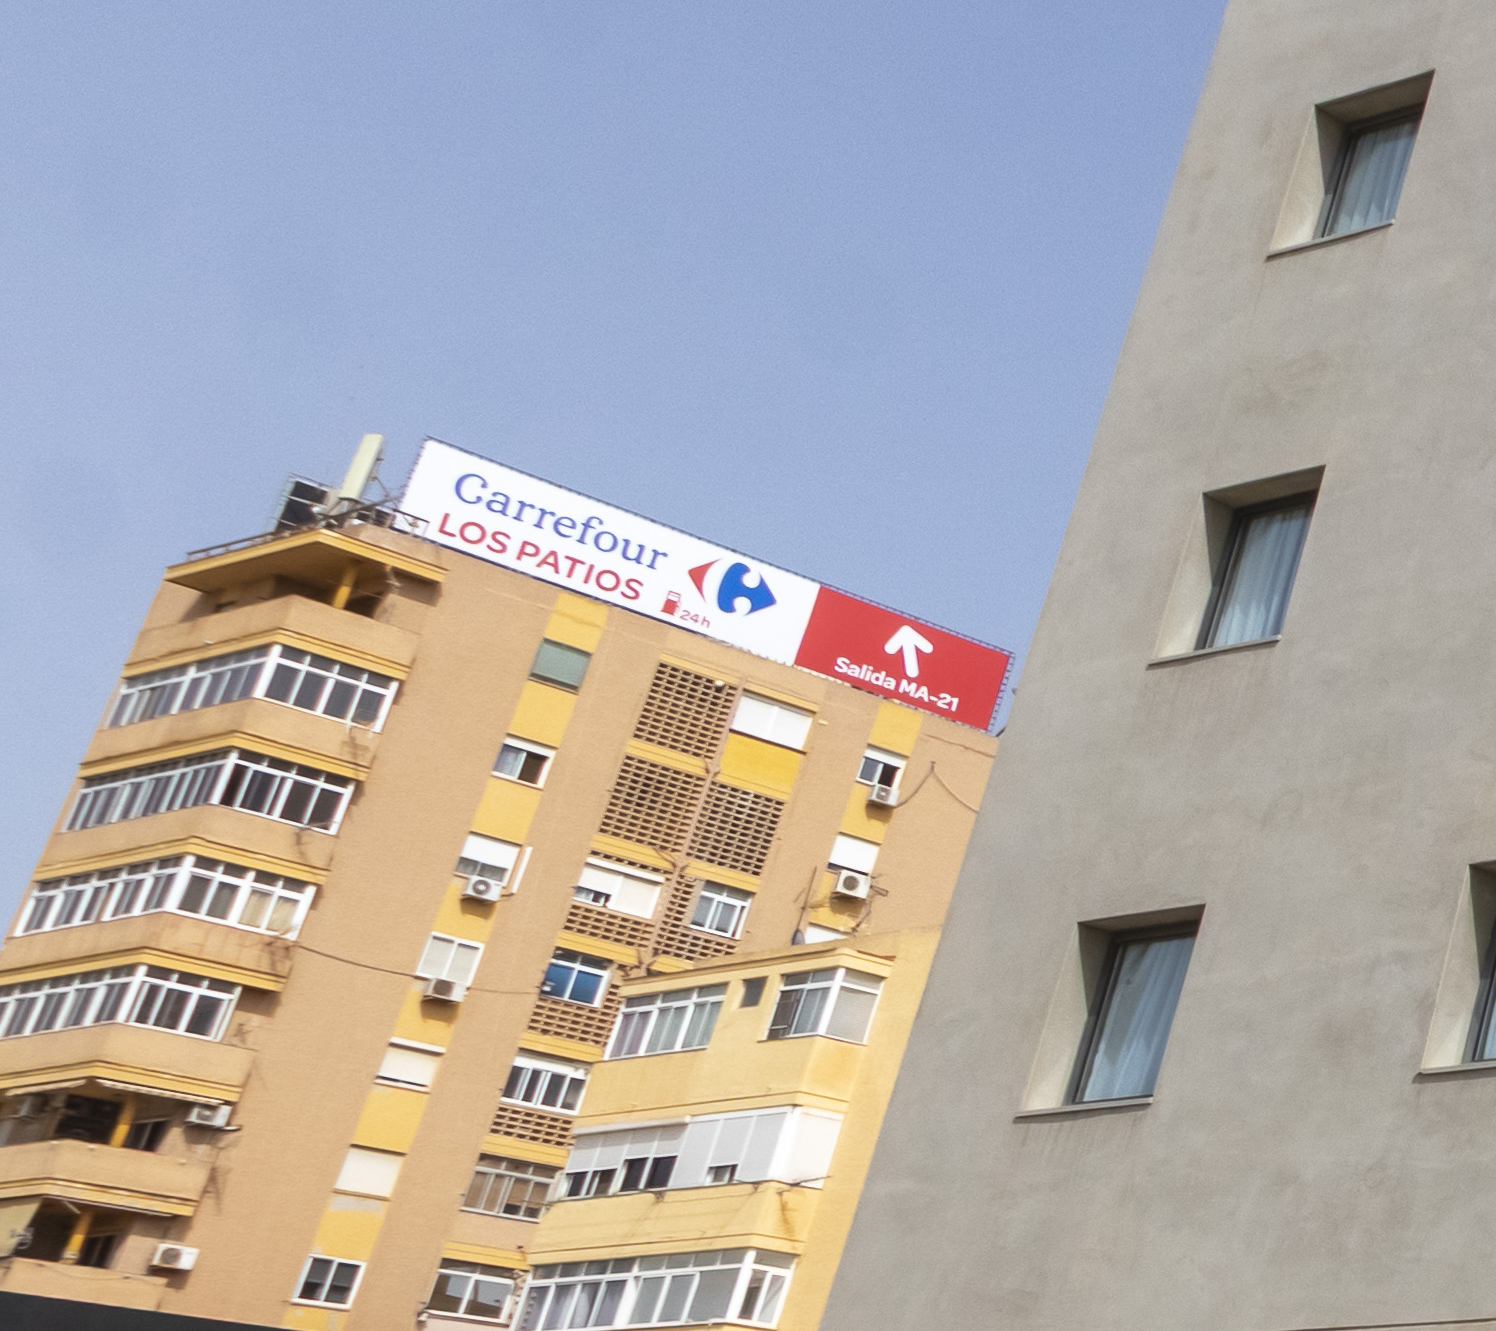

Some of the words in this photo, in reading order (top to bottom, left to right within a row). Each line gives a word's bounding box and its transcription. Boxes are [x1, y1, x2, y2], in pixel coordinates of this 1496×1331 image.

[438, 512, 511, 554] LOS
[515, 540, 644, 600] PATIOS
[454, 473, 668, 570] Carrefour
[834, 657, 896, 690] Salida
[899, 679, 959, 712] MA-21
